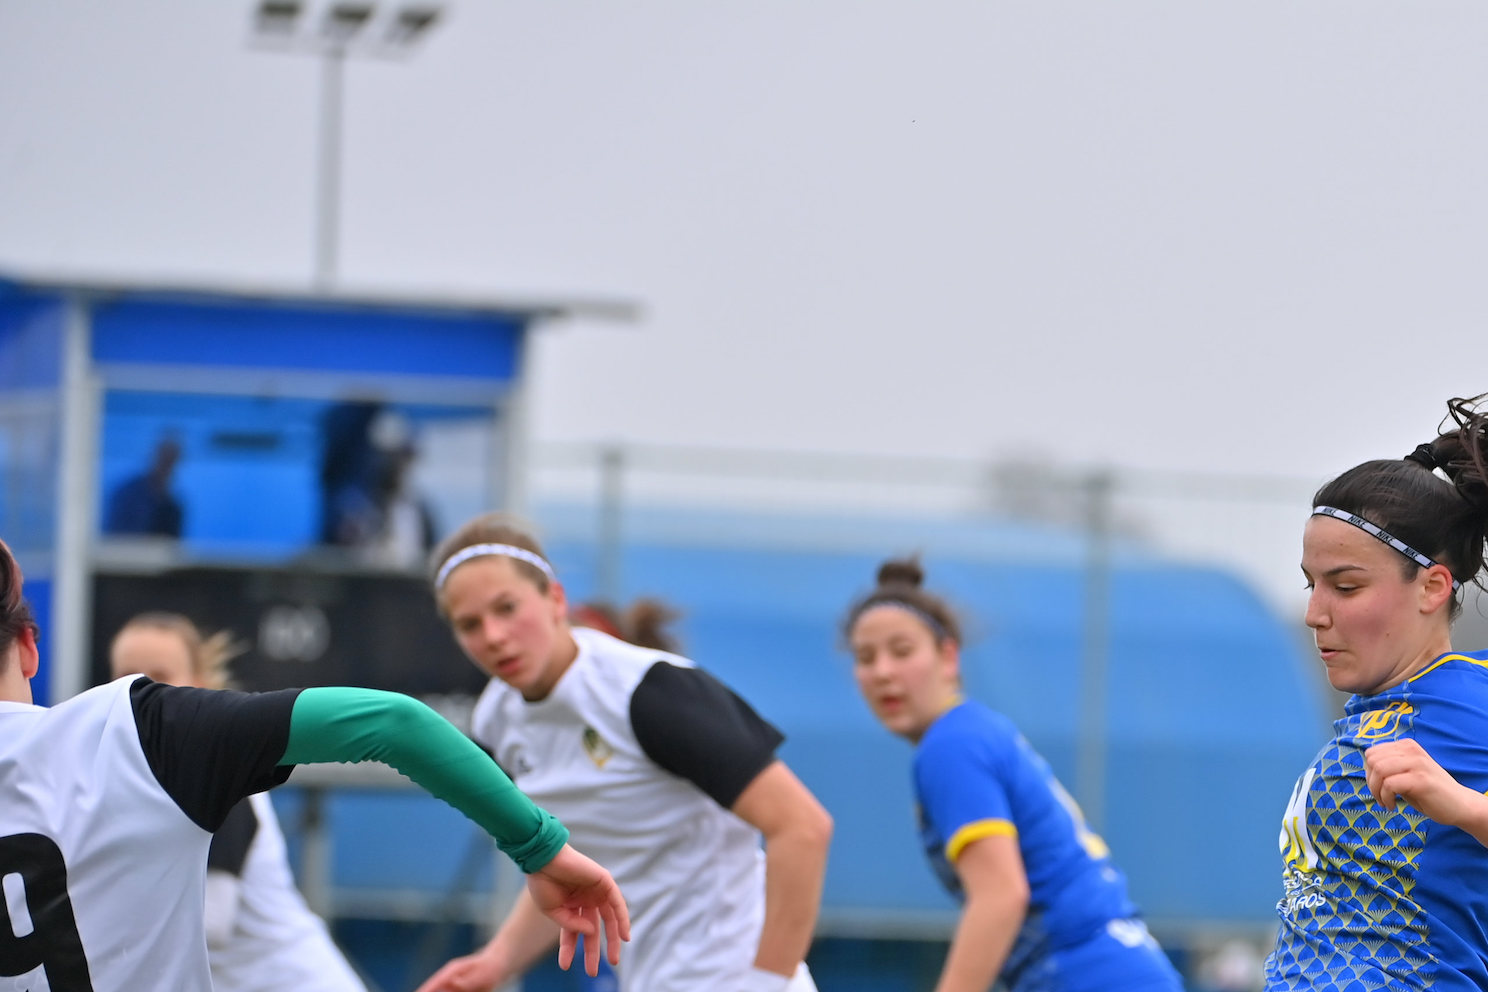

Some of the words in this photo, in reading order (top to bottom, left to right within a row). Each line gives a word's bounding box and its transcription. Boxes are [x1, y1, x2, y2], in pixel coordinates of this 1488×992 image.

[1322, 508, 1336, 516] NIKE
[1348, 515, 1366, 528] NIKE
[1376, 531, 1395, 544] NIKE
[1403, 547, 1420, 560] NIKE
